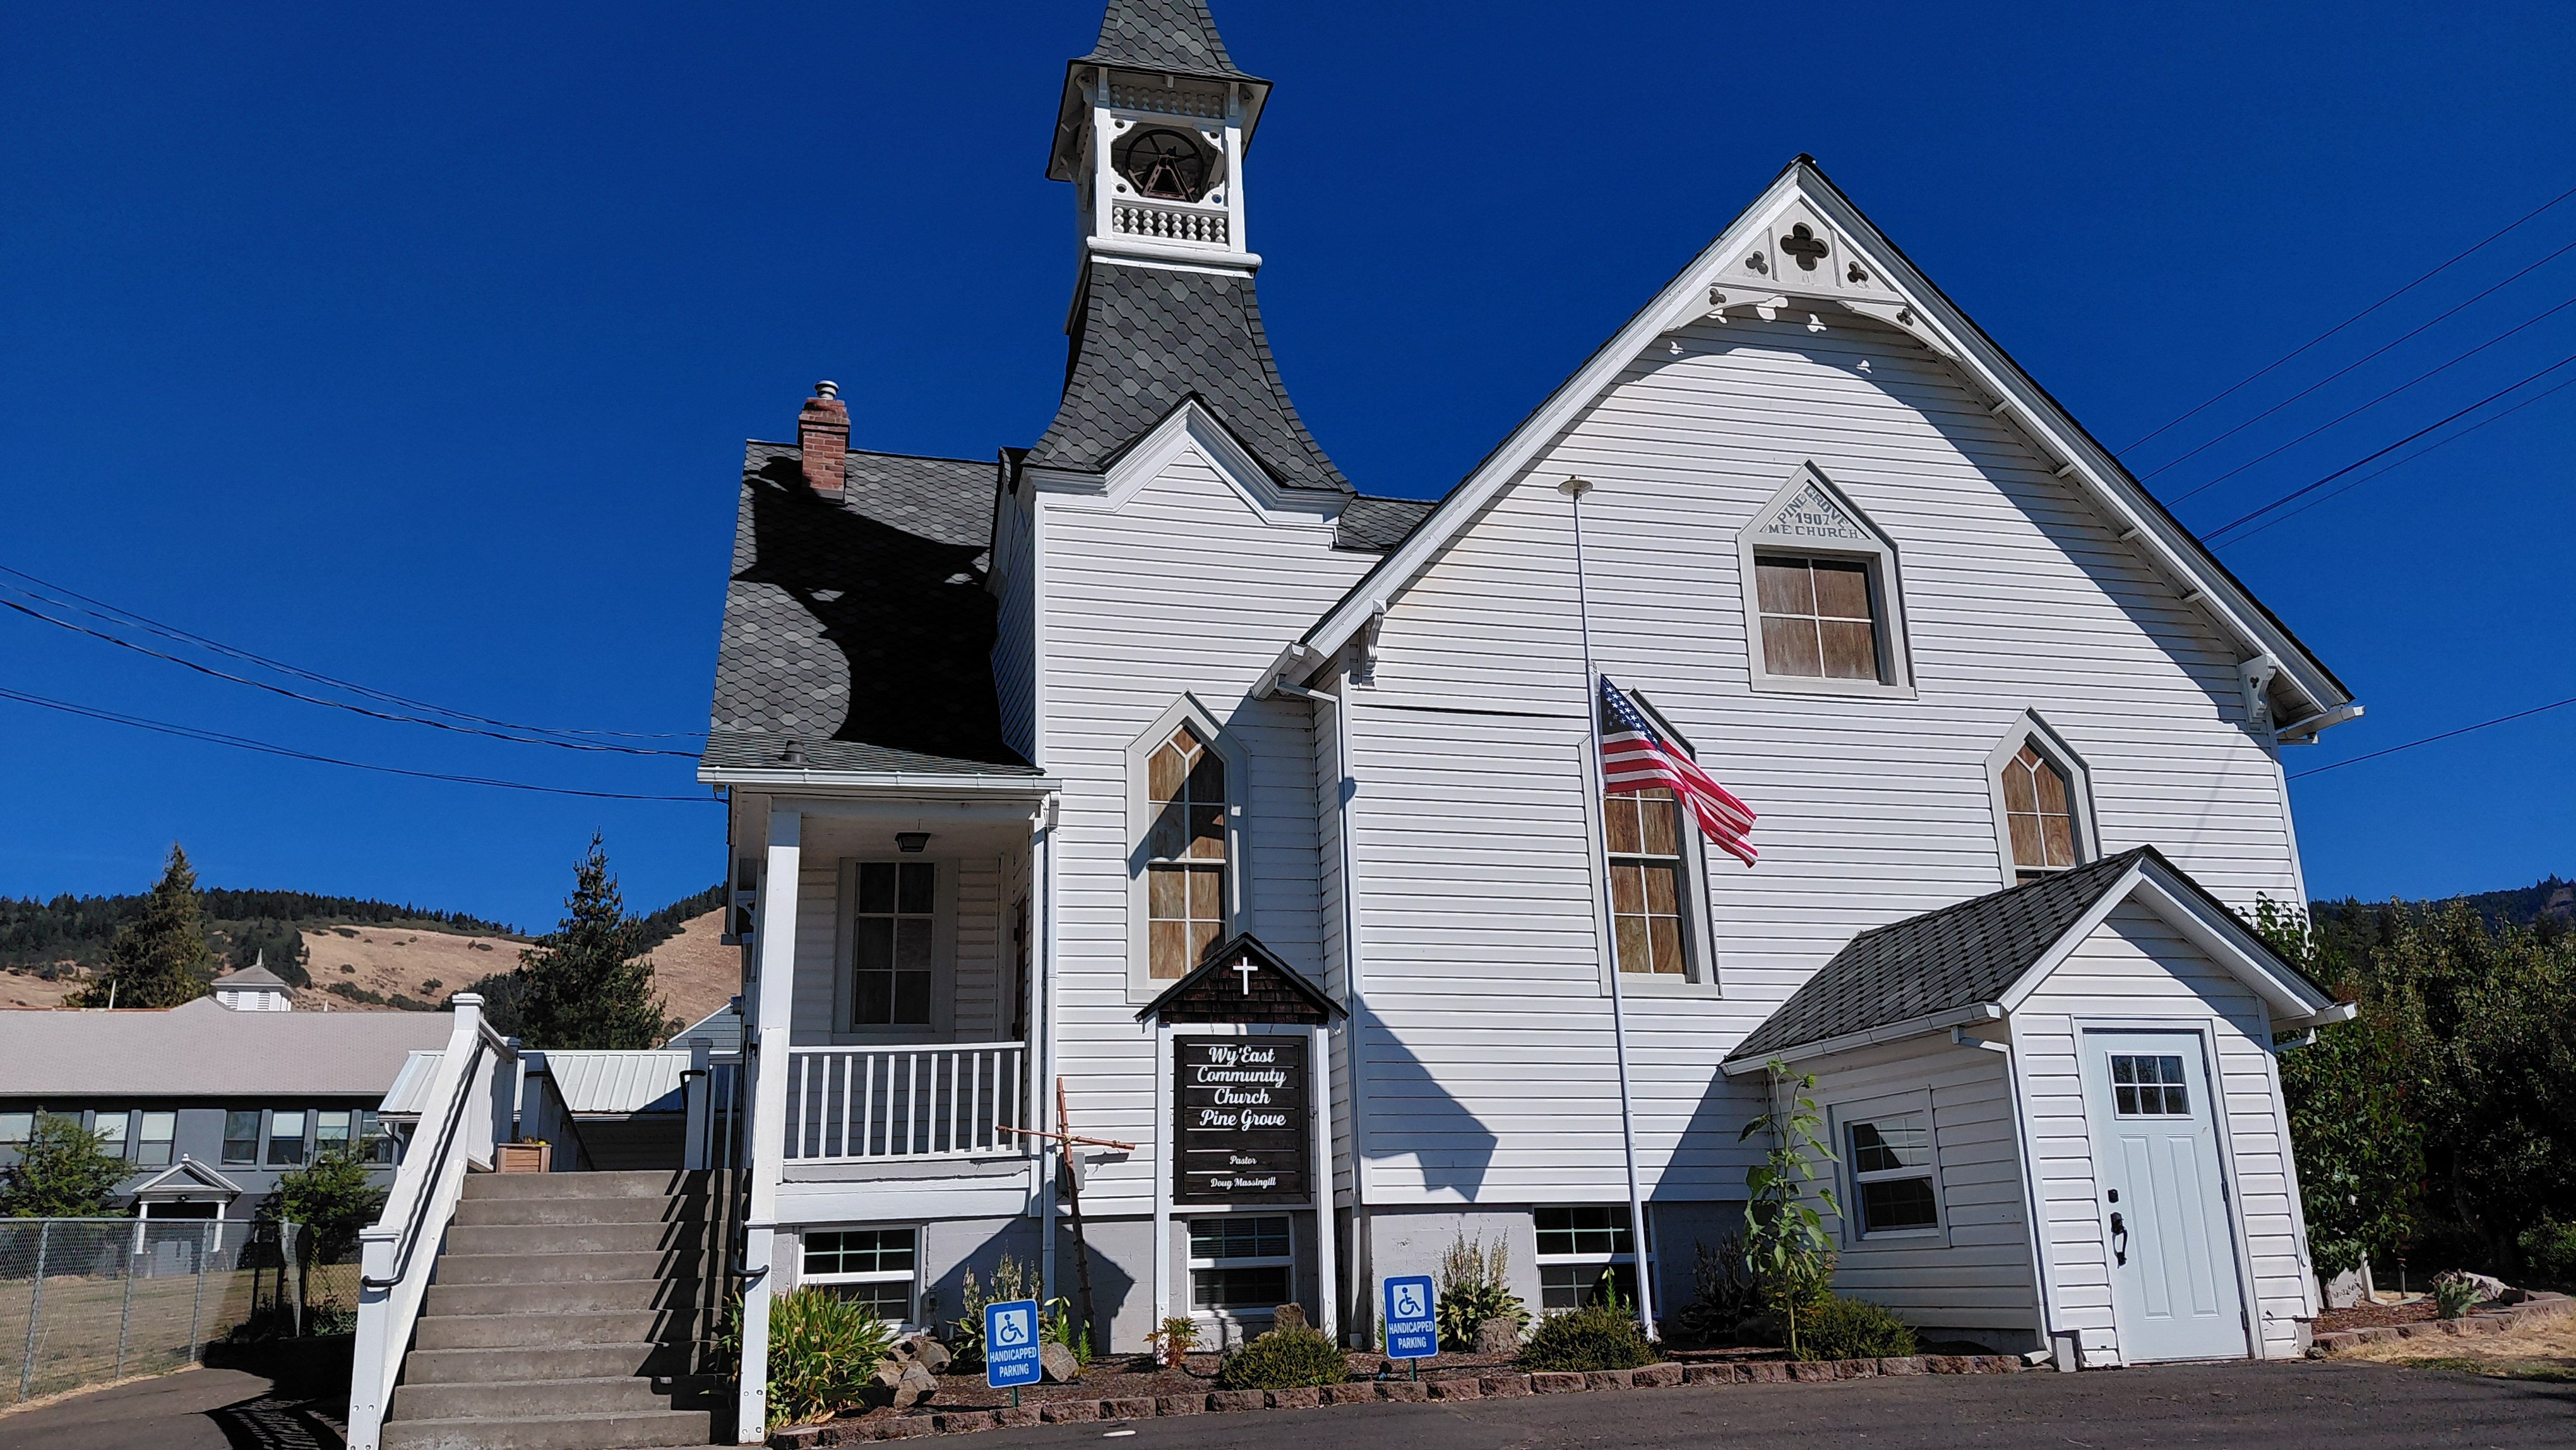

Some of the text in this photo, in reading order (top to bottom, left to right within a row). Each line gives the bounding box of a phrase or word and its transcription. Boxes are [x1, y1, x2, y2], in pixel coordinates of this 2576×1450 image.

[1777, 485, 1849, 528] PINE GROVE
[1796, 512, 1830, 525] 1907
[1795, 525, 1859, 539] CHURCH
[1208, 1046, 1275, 1066] Wy'East
[1197, 1066, 1287, 1088] Community
[1214, 1088, 1271, 1105] Church
[1200, 1110, 1286, 1131] Pine Grove
[1230, 1156, 1257, 1165] Pastor
[1210, 1177, 1276, 1189] Doug Massingill
[1388, 1321, 1434, 1334] HANDICAPPED
[1398, 1336, 1427, 1349] PARKING
[989, 1346, 1037, 1363] HANDICAPPED
[999, 1363, 1029, 1378] PARKING
